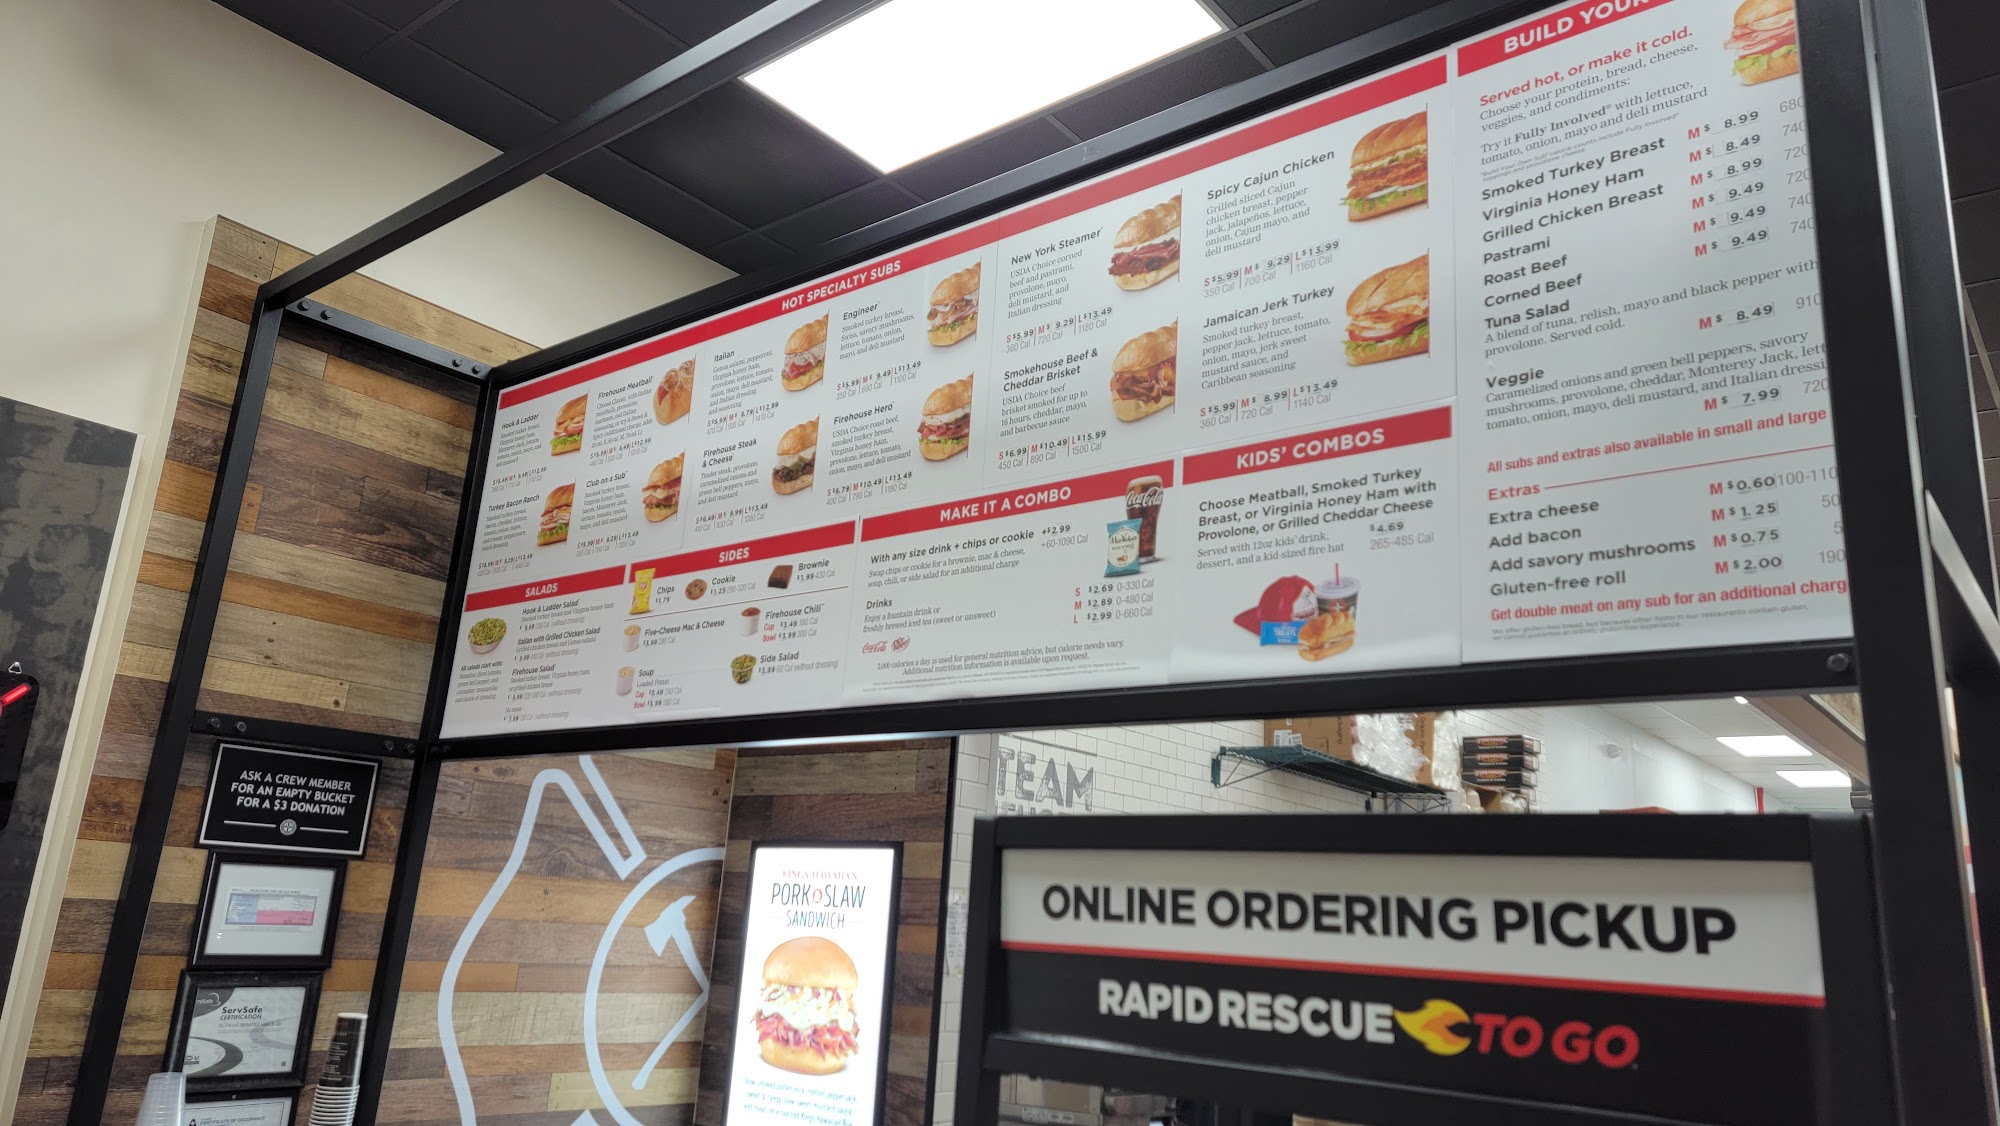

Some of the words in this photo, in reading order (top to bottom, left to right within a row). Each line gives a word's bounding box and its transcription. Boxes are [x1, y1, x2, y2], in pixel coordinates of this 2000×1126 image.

[1504, 16, 1574, 54] BUILD
[1480, 80, 1530, 106] Served
[1534, 71, 1564, 88] hot,
[1567, 64, 1584, 76] or
[1588, 48, 1632, 70] make
[1636, 41, 1647, 53] it
[1651, 25, 1692, 48] cold.
[1479, 101, 1521, 120] Choose
[1524, 90, 1552, 108] your
[1555, 75, 1603, 98] protein,
[1606, 58, 1646, 78] bread,
[1649, 43, 1697, 64] cheese,
[1207, 182, 1240, 200] Spicy
[1243, 170, 1278, 187] Cajun
[1282, 151, 1334, 174] Chicken
[1482, 172, 1544, 200] Smoked
[1548, 156, 1604, 180] Turkey
[1610, 137, 1665, 163] Breast
[1482, 196, 1542, 221] Virginia
[1547, 180, 1599, 203] Honey
[1605, 168, 1643, 187] Ham
[1483, 218, 1533, 242] Grilled
[1538, 202, 1603, 227] Chicken
[1608, 184, 1663, 208] Breast
[1011, 252, 1031, 265] New
[1034, 243, 1056, 257] York
[1058, 229, 1101, 249] Steamer
[1483, 236, 1550, 264] Pastrami
[1484, 266, 1526, 286] Roast
[1531, 254, 1567, 274] Beef
[782, 294, 804, 310] HOT
[807, 272, 867, 302] SPECIALTY
[870, 260, 901, 280] SUBS
[1484, 283, 1540, 307] Corned
[1545, 273, 1582, 293] Beef
[842, 303, 878, 320] Engineer
[1203, 306, 1258, 328] Jamaican
[1262, 297, 1288, 312] Jerk
[1291, 285, 1334, 304] Turkey
[1484, 313, 1520, 329] Tuna
[1525, 299, 1569, 320] Salad
[714, 350, 734, 362] Italian
[1004, 358, 1064, 380] Smokehouse
[1066, 349, 1089, 364] Beef
[1003, 375, 1044, 392] Cheddar
[1046, 365, 1080, 381] Brisket
[1486, 368, 1544, 388] Veggie
[833, 409, 872, 425] Firehouse
[874, 401, 893, 414] Hero
[703, 444, 736, 457] Firehouse
[737, 437, 757, 449] Steak
[1292, 428, 1384, 458] COMBOS
[1487, 460, 1502, 473] All
[1505, 457, 1533, 470] subs
[1536, 451, 1559, 465] and
[1562, 446, 1600, 461] extras
[1604, 441, 1630, 454] also
[1633, 430, 1693, 449] available
[1697, 427, 1710, 439] in
[1714, 418, 1752, 436] small
[1756, 413, 1784, 430] and
[1788, 409, 1826, 424] large
[488, 503, 505, 512] Turkey
[505, 499, 522, 508] Bacon
[522, 494, 539, 504] Ranch
[1198, 511, 1241, 526] Breast,
[1244, 510, 1258, 519] or
[1262, 499, 1313, 516] Virginia
[1317, 493, 1361, 508] Honey
[1366, 488, 1399, 501] Ham
[1403, 480, 1436, 495] with
[1199, 497, 1245, 512] Choose
[1249, 485, 1308, 503] Meatball,
[1311, 474, 1367, 493] Smoked
[1372, 468, 1421, 483] Turkey
[1488, 484, 1540, 501] Extras
[940, 503, 979, 522] MAKE
[983, 499, 997, 514] IT
[1000, 497, 1011, 511] A
[1014, 486, 1071, 508] COMBO
[1489, 510, 1532, 525] Extra
[1538, 501, 1599, 518] cheese
[1198, 525, 1259, 541] Provolone,
[1262, 522, 1275, 532] or
[1278, 513, 1319, 530] Grilled
[1322, 506, 1379, 523] Cheddar
[1382, 499, 1433, 514] Cheese
[870, 553, 890, 564] With
[892, 551, 907, 560] any
[909, 547, 926, 557] size
[928, 542, 951, 554] drink
[962, 538, 986, 549] chips
[989, 536, 999, 545] or
[1001, 529, 1034, 543] cookie
[1488, 532, 1522, 548] Add
[1528, 528, 1581, 544] bacon
[718, 546, 749, 563] SIDES
[798, 558, 829, 571] Brownie
[1489, 556, 1523, 572] Add
[1527, 552, 1583, 568] savory
[1589, 539, 1696, 561] mushrooms
[524, 582, 558, 597] SALADS
[656, 585, 674, 594] Chips
[711, 574, 735, 585] Cookie
[1490, 576, 1590, 596] Gluten-free
[1595, 570, 1625, 586] roll
[765, 608, 802, 619] Firehouse
[803, 604, 822, 614] Chili
[866, 598, 892, 609] Drinks
[511, 667, 538, 676] Firehouse
[539, 663, 555, 672] Salad
[759, 654, 776, 663] Side
[778, 651, 799, 661] Salad
[638, 669, 654, 677] Soup
[240, 770, 262, 781] ASK
[264, 773, 272, 783] A
[275, 774, 307, 786] CREW
[308, 778, 351, 791] MEMBER
[997, 746, 1093, 812] TEAM
[231, 782, 254, 794] FOR
[256, 785, 273, 796] AN
[275, 787, 312, 800] EMPTY
[314, 791, 356, 804] BUCKET
[236, 796, 260, 808] FOR
[262, 799, 271, 809] A
[273, 799, 288, 811] $3
[290, 801, 346, 816] DONATION
[771, 883, 811, 906] PORK
[824, 884, 866, 909] SLAW
[786, 910, 845, 929] SANDWICH
[1042, 885, 1196, 926] ONLINE
[1207, 890, 1478, 942] ORDERING
[1494, 900, 1737, 956] PICKUP
[221, 1005, 263, 1014] ServSafe
[1099, 979, 1213, 1024] RAPID
[1218, 988, 1396, 1045] RESCUE
[1473, 1012, 1544, 1058] TO
[1551, 1020, 1640, 1068] GO
